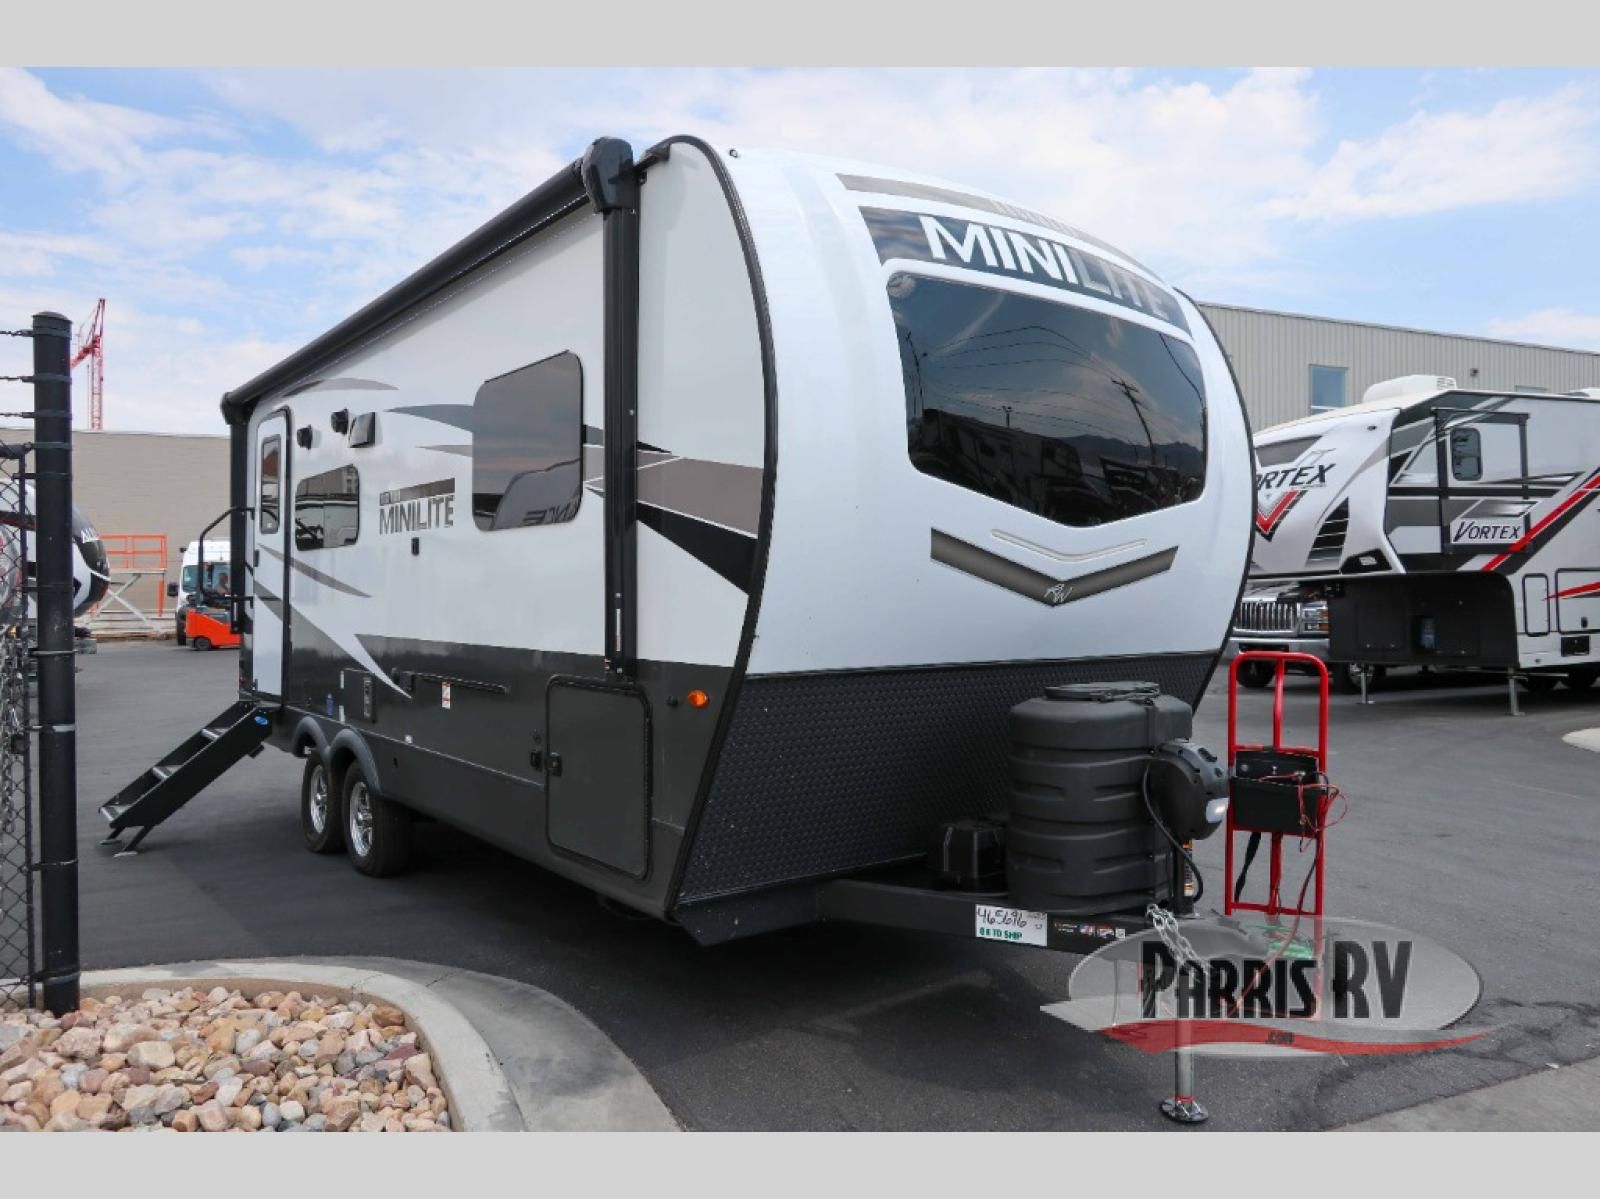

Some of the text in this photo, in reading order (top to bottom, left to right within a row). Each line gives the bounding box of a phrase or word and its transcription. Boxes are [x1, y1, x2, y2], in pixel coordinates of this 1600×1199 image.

[919, 215, 1169, 320] MINILITE
[379, 494, 454, 534] MINILITE
[1453, 521, 1521, 542] VORTEX
[1004, 930, 1023, 940] SHIP
